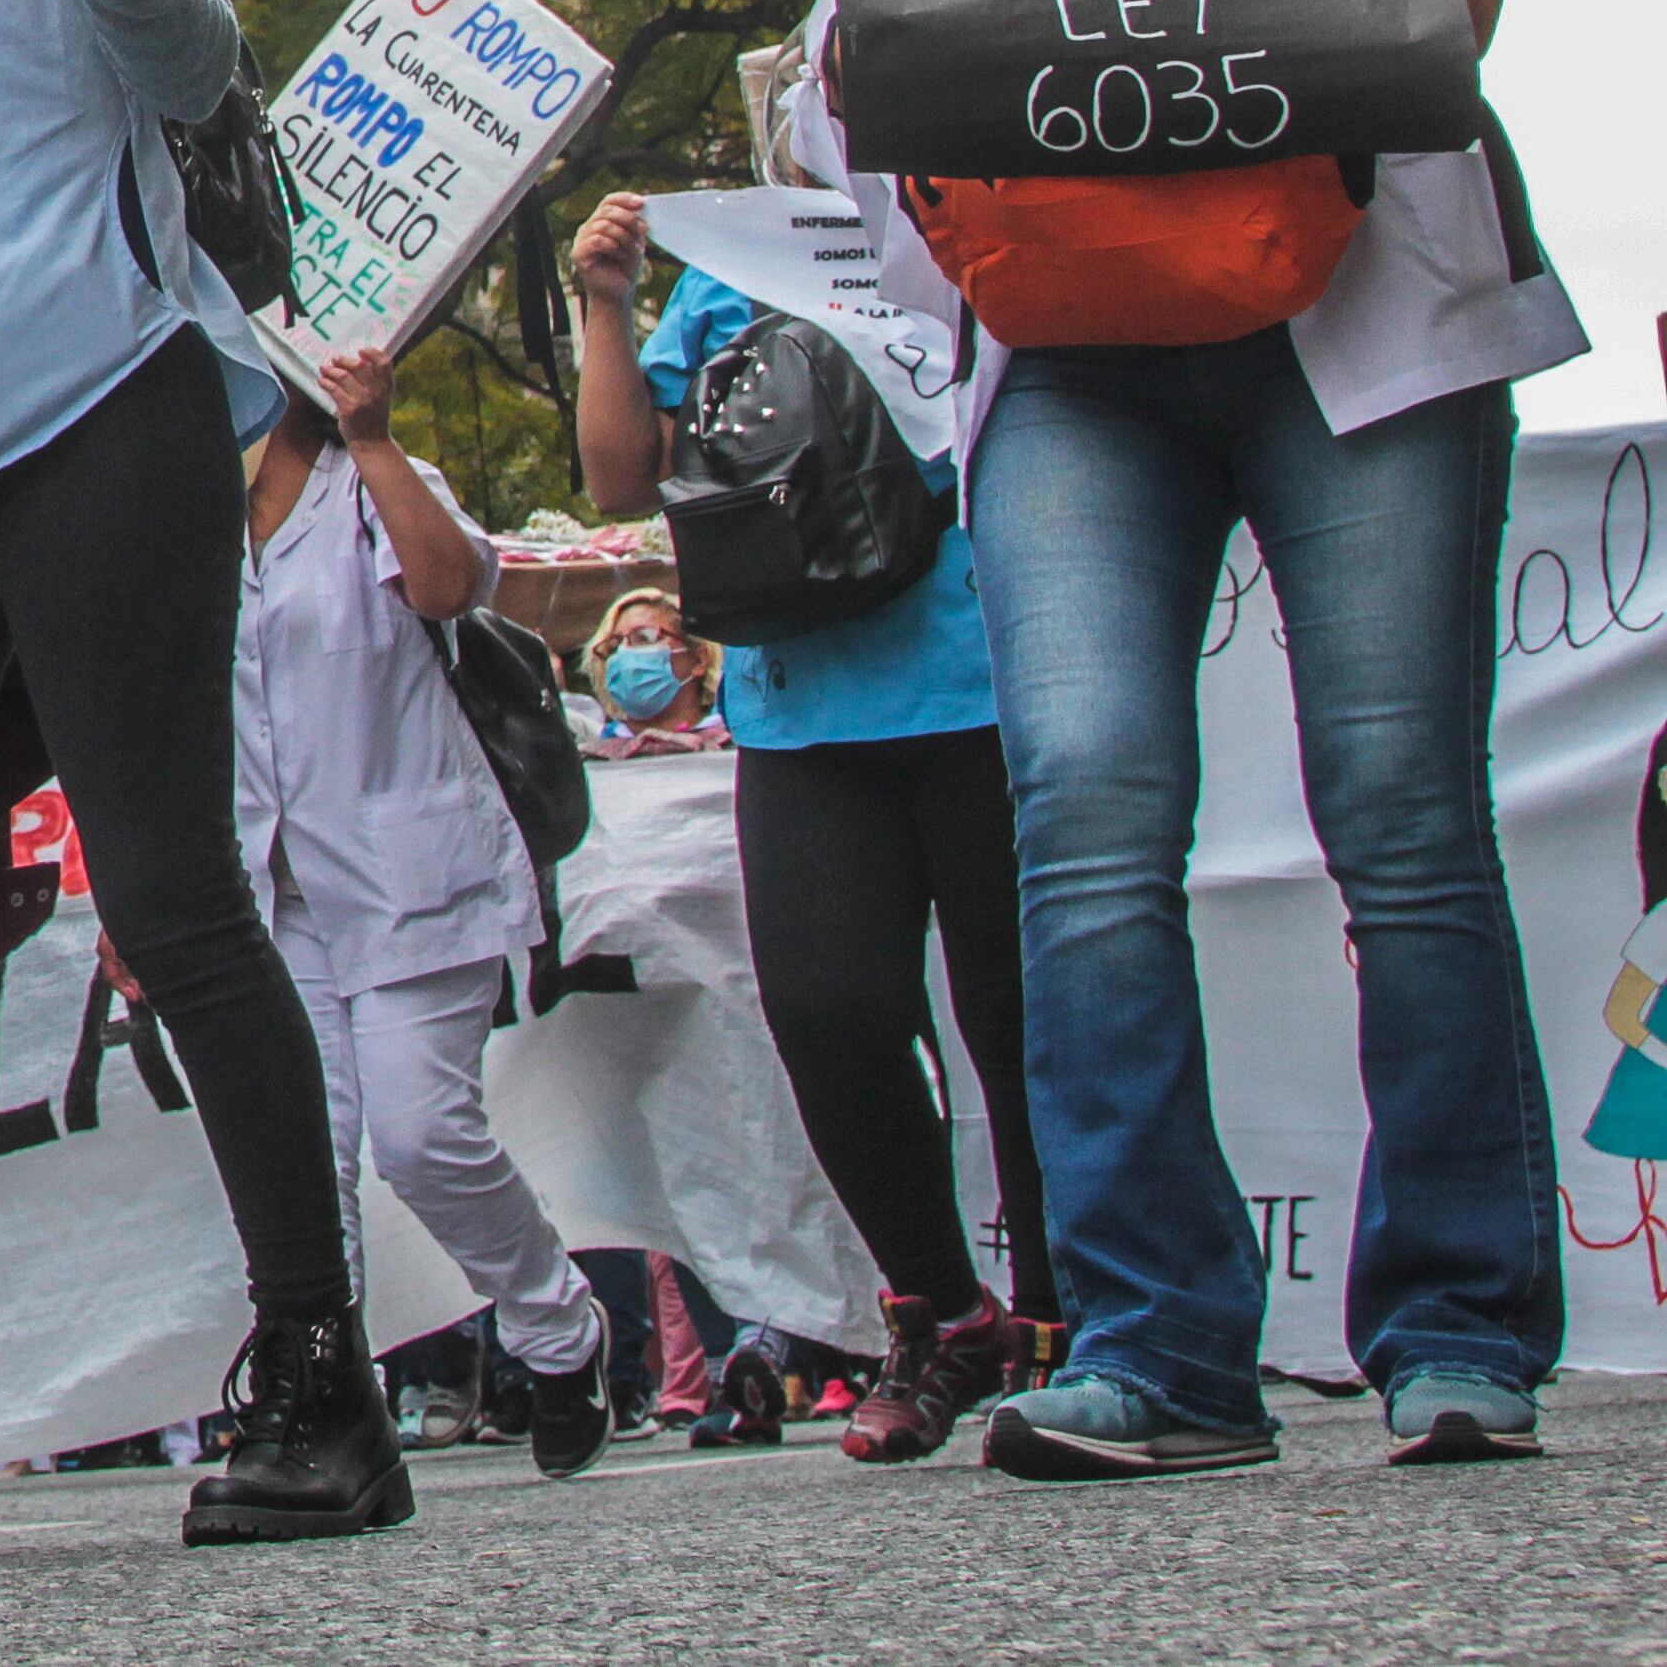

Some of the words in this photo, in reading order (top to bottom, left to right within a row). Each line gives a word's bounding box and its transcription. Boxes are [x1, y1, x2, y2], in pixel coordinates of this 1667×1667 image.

[384, 31, 522, 157] CUARENTENA
[450, 1, 582, 121] ROMPO
[1026, 49, 1292, 153] 6035
[294, 52, 426, 168] ROMPO
[413, 151, 466, 202] EL
[350, 258, 394, 315] EL
